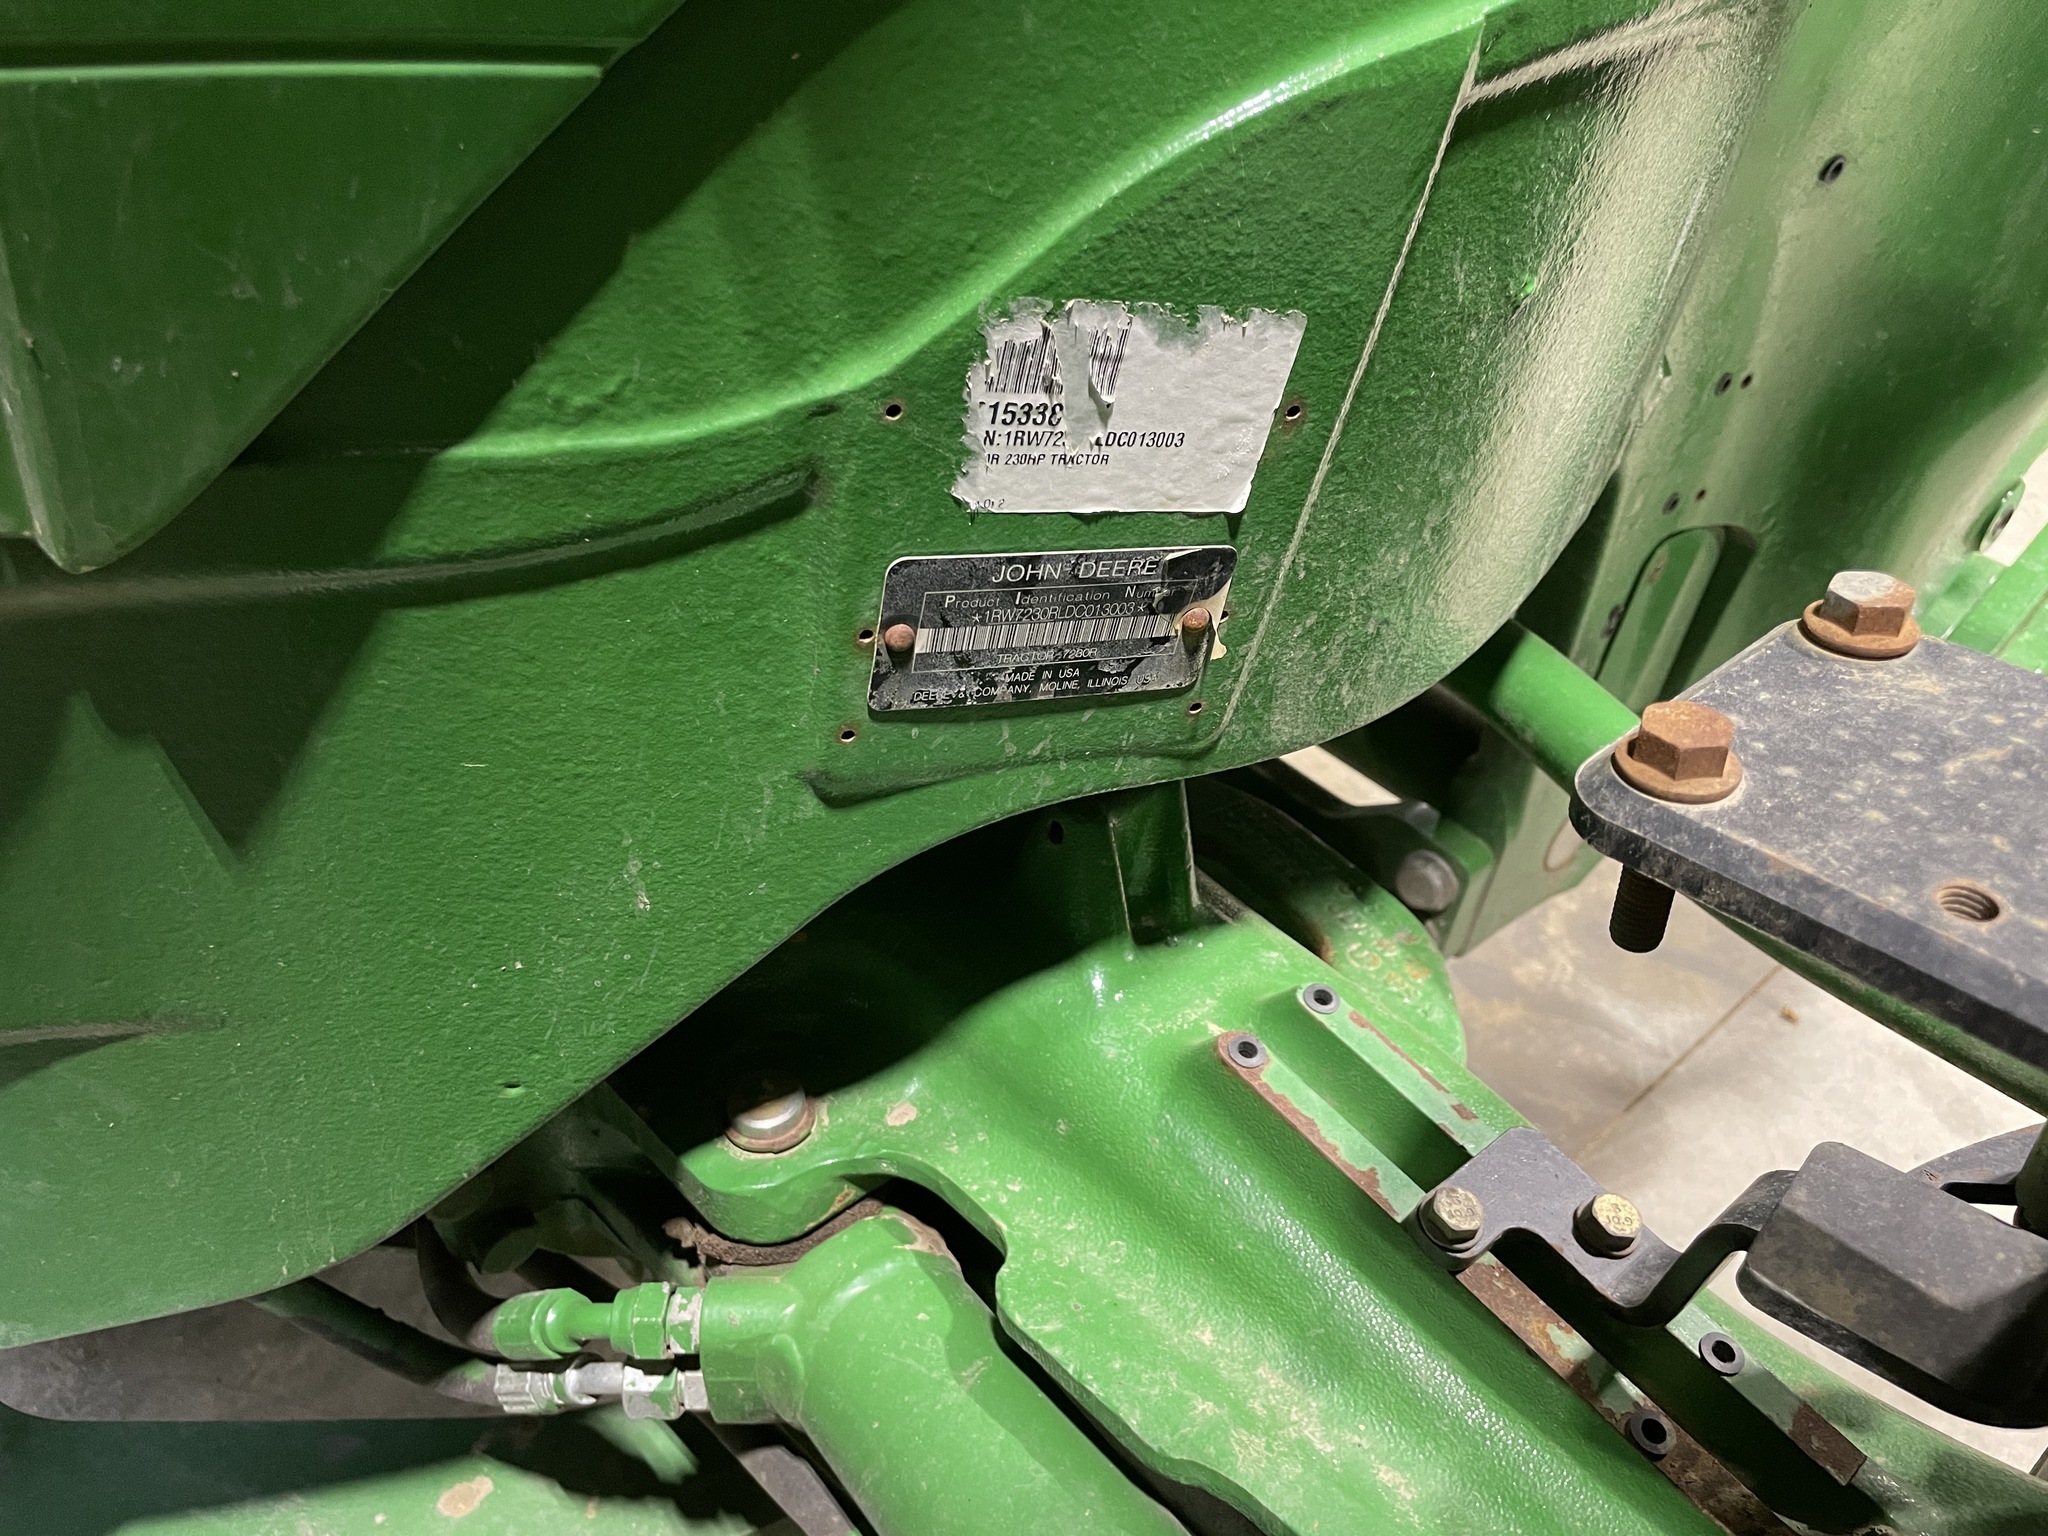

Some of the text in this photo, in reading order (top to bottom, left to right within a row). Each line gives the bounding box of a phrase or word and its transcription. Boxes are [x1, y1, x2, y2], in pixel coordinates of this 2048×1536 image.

[1004, 453, 1046, 466] 230HP
[1051, 453, 1110, 466] TRACTOR
[992, 559, 1157, 583] JOHN DEERE
[944, 584, 1178, 609] Product Identification Numer
[1005, 668, 1080, 683] MADE IN USA
[1038, 680, 1081, 693] MOLINE,
[1086, 675, 1129, 689] ILLINOIS
